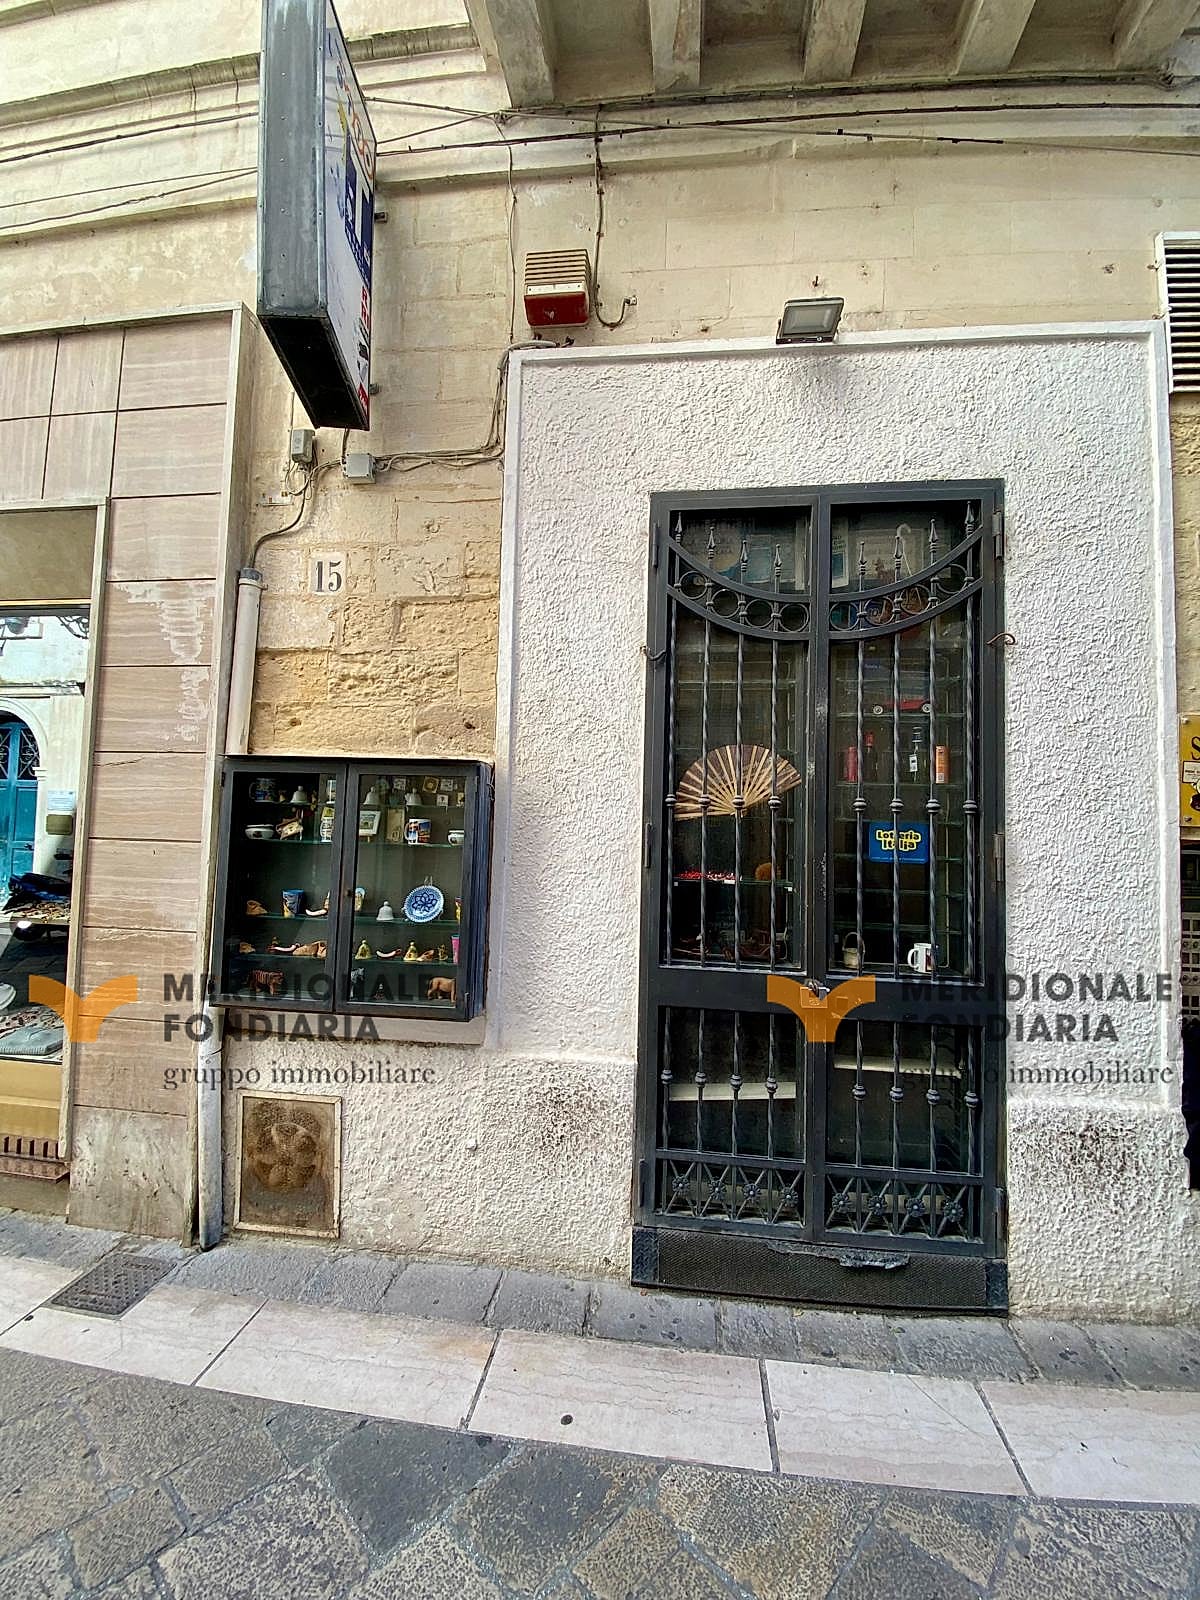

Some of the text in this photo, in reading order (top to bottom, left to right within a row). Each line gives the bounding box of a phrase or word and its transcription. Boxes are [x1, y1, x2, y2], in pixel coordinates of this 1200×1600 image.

[315, 560, 342, 592] 15
[876, 830, 921, 842] Loteria
[882, 839, 916, 851] Itlia
